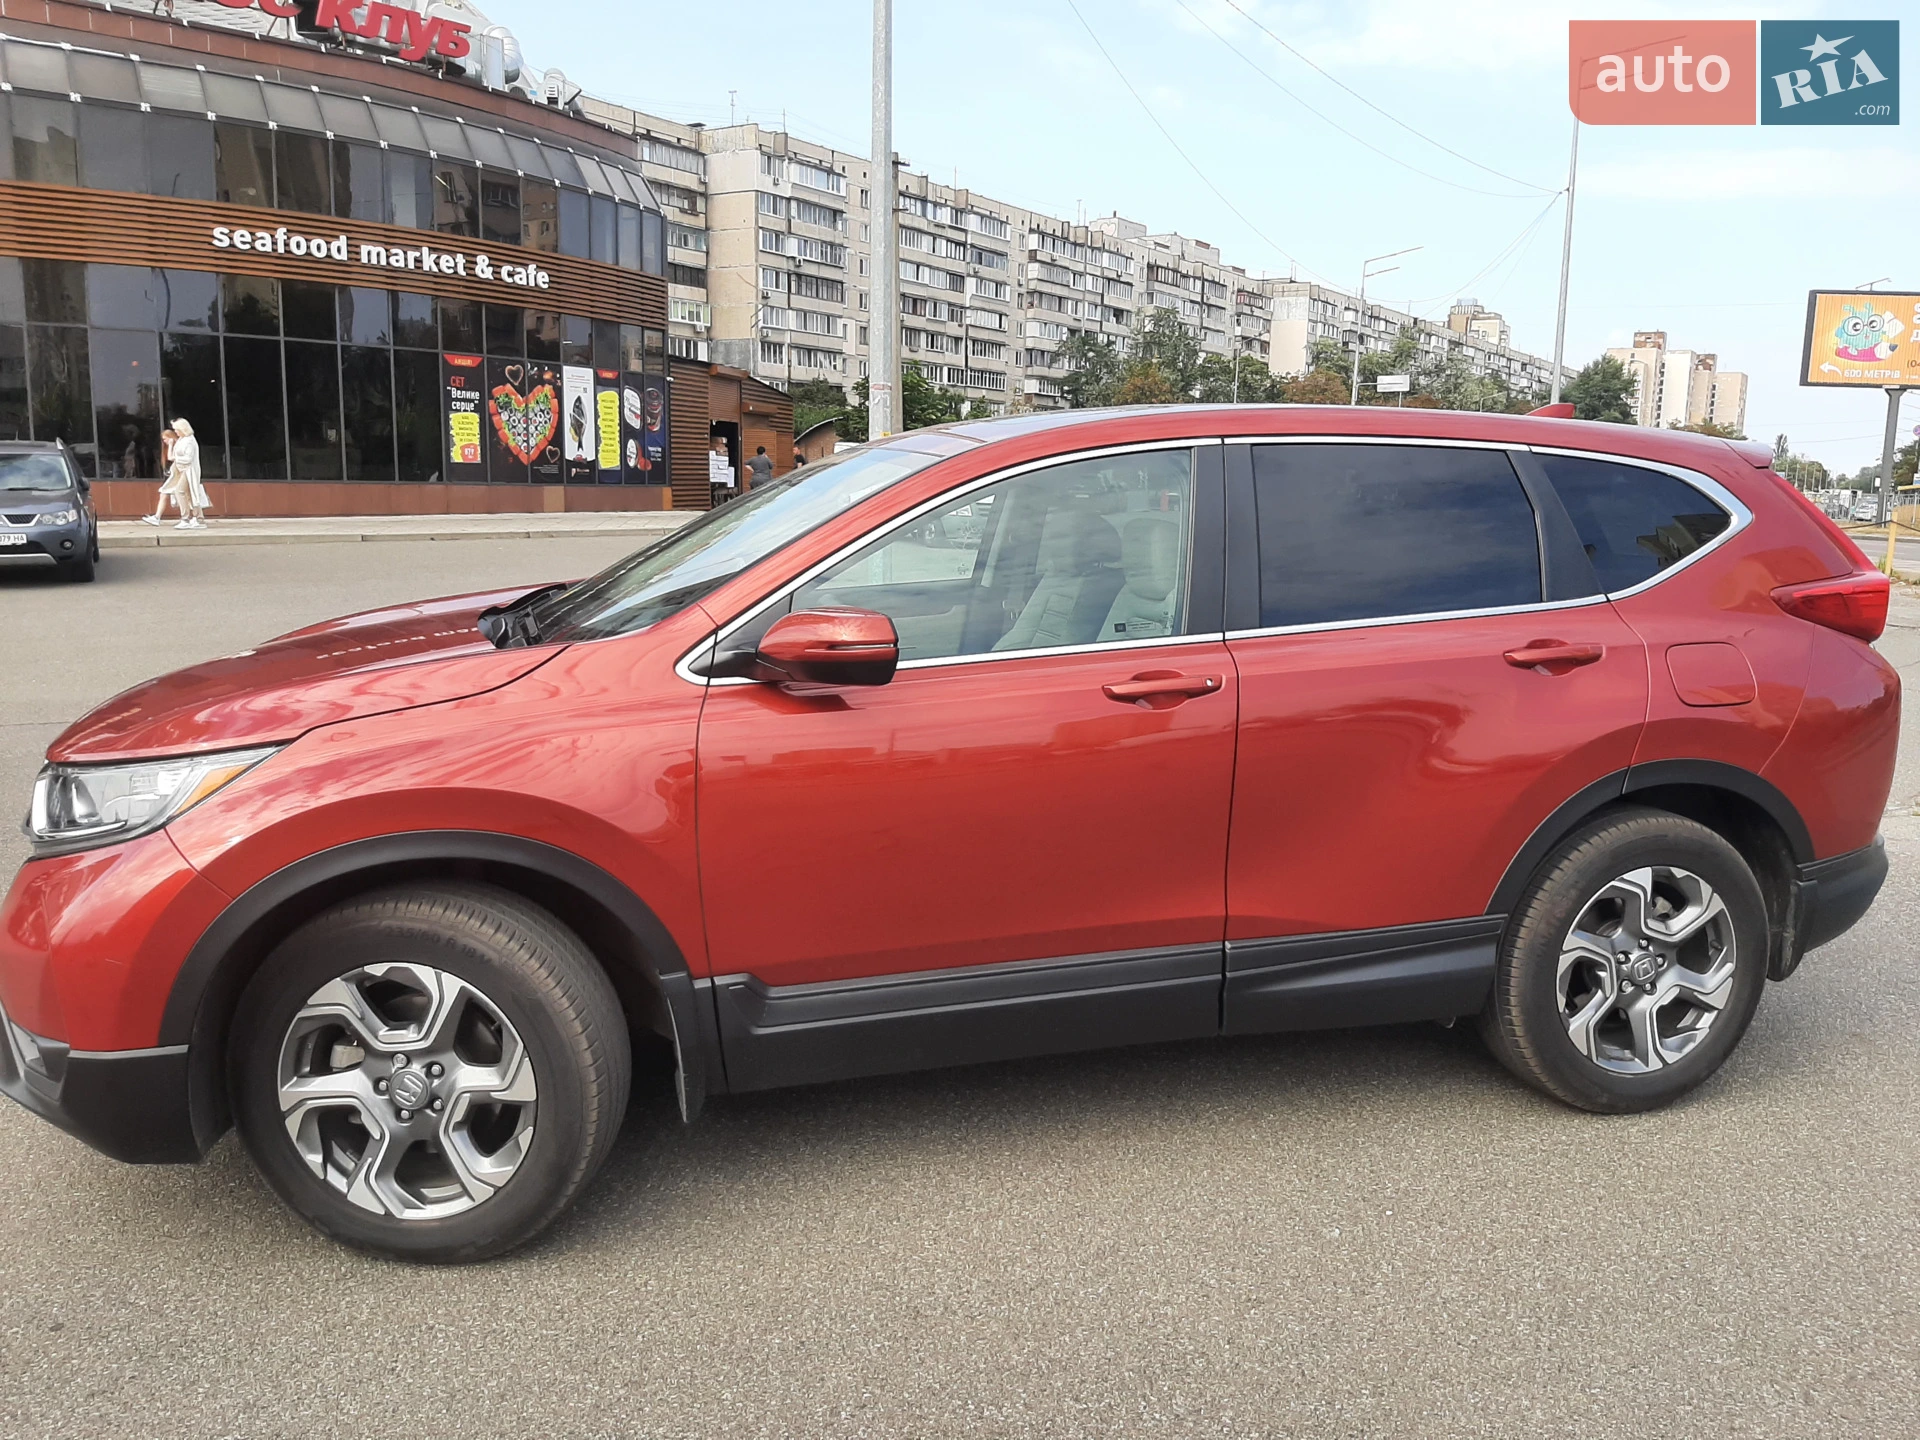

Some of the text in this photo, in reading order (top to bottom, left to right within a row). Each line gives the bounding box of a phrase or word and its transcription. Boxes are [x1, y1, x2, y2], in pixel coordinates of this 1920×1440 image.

[211, 226, 550, 289] seafood market & cafe
[1864, 369, 1901, 379] МЕТРІВ
[450, 375, 466, 388] СЕТ
[446, 386, 480, 400] "Велике
[451, 400, 479, 412] серце"
